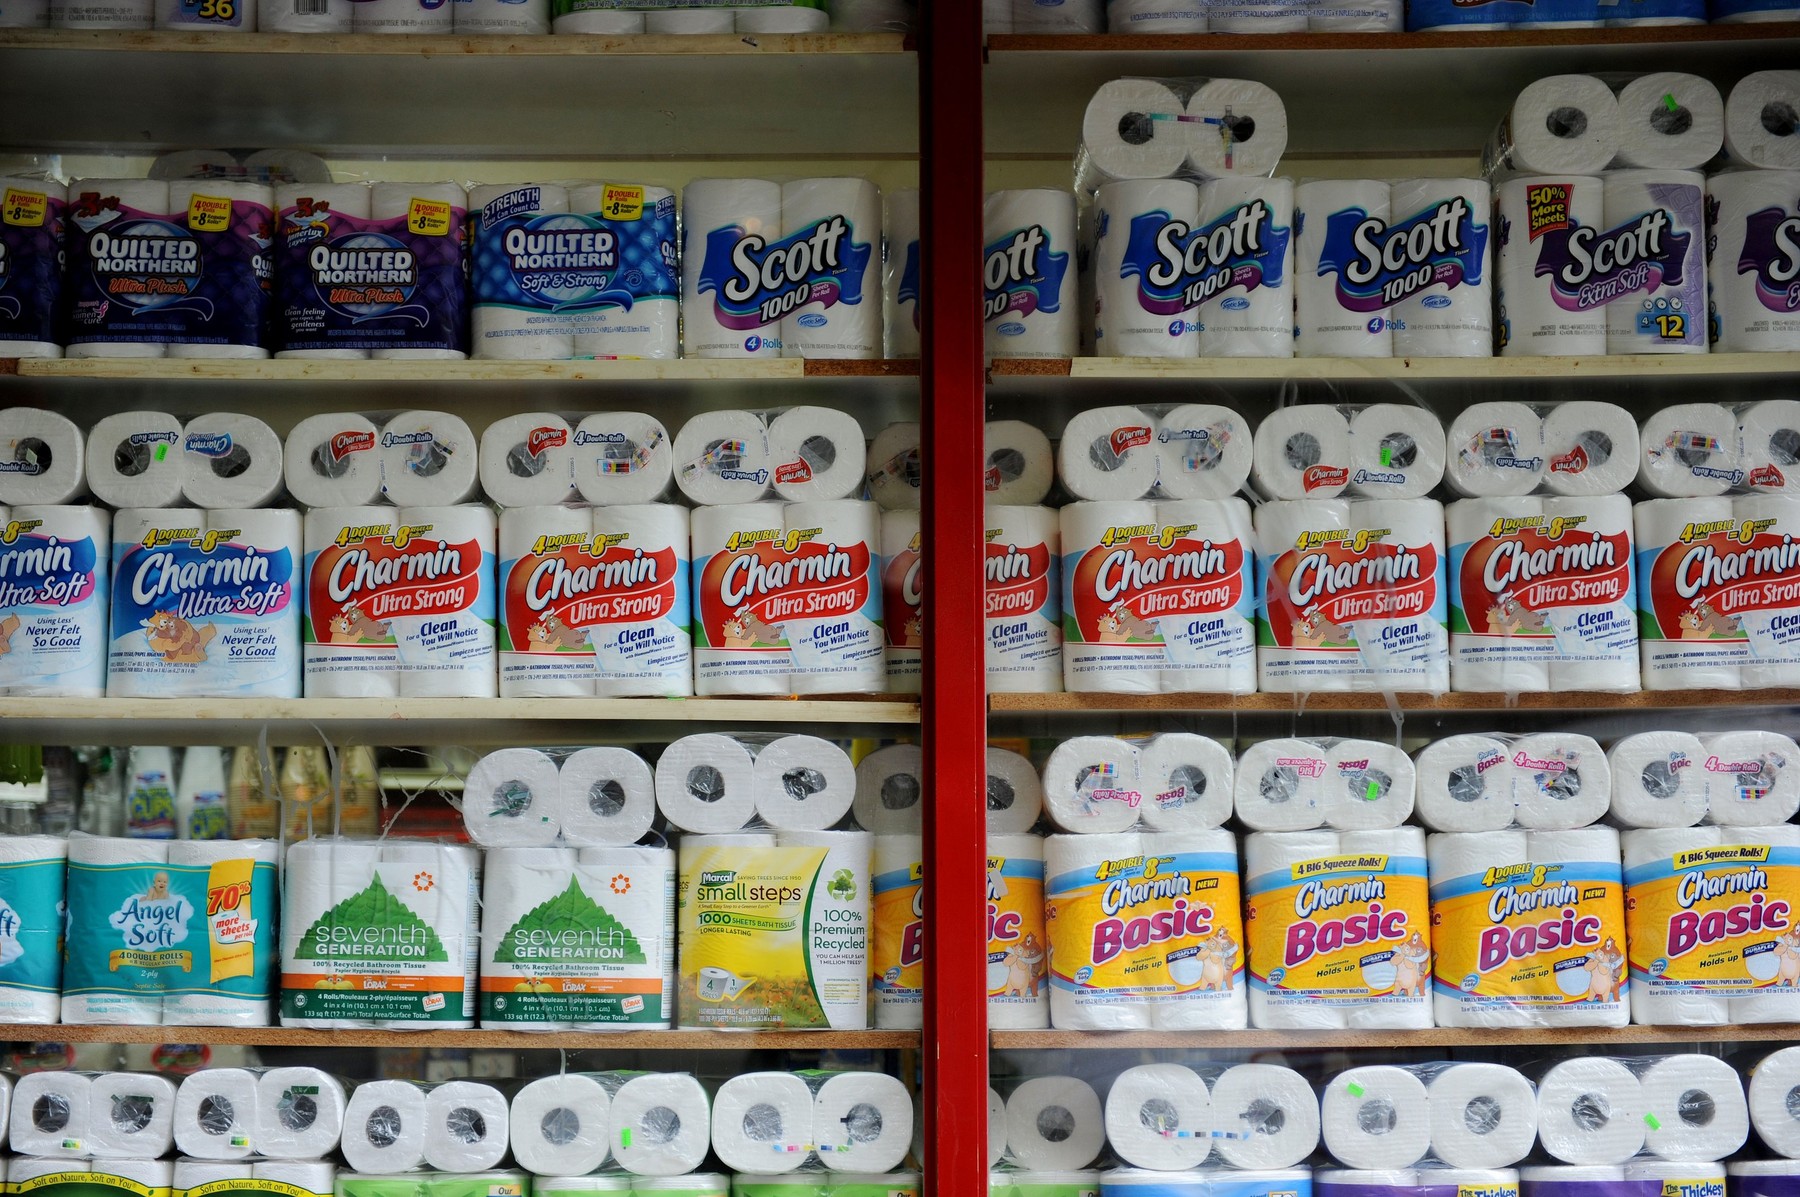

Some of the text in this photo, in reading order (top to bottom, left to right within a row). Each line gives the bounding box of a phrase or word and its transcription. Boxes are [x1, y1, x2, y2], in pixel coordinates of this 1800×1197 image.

[199, 0, 236, 20] 36
[483, 187, 540, 218] STRENGTH
[1529, 185, 1566, 202] 50%
[497, 203, 540, 221] Can Count On
[1531, 203, 1565, 217] More
[1531, 213, 1566, 231] Sheets
[89, 231, 198, 261] QUILTED
[506, 228, 614, 256] QUILTED
[1147, 199, 1266, 287] Scott
[1346, 196, 1466, 283] Scott
[1561, 208, 1668, 284] Scott
[96, 257, 197, 275] NORTHERN
[310, 244, 413, 271] QUILTED
[514, 252, 614, 269] NORTHERN
[725, 214, 847, 302] Scott
[985, 224, 1043, 291] ott
[317, 270, 411, 284] NORTHERN
[522, 273, 608, 292] Soft & Strong
[1384, 264, 1433, 304] 1000
[109, 277, 189, 296] Ultra Plush
[1183, 266, 1232, 308] 1000
[1578, 265, 1648, 308] Extra Soft
[330, 288, 405, 304] Ultra Plush
[759, 282, 810, 323] 1000
[1185, 321, 1206, 334] Rolls
[1385, 319, 1406, 331] Rolls
[1656, 315, 1685, 338] 12
[762, 338, 784, 349] Rolls
[337, 432, 370, 448] Charmin
[1310, 468, 1344, 482] Charmin
[350, 524, 392, 537] DOUBLE
[1504, 514, 1545, 530] DOUBLE
[1695, 519, 1735, 534] DOUBLE
[157, 527, 200, 539] DOUBLE
[741, 528, 781, 542] DOUBLE
[1095, 539, 1226, 602] Charmin
[1483, 530, 1615, 593] Charmin
[1675, 533, 1800, 599] Charmin
[131, 545, 269, 605] Charmin
[328, 539, 462, 603] Charmin
[525, 547, 658, 612] Charmin
[720, 542, 852, 608] Charmin
[1289, 544, 1420, 607] Charmin
[43, 573, 88, 606] Soft
[1528, 577, 1619, 607] Ultra Strong
[178, 583, 284, 619] Ultra Soft
[372, 585, 466, 617] Ultra Strong
[569, 593, 662, 625] Ultra Strong
[765, 588, 856, 620] Ultra Strong
[986, 590, 1035, 613] Strong
[1140, 585, 1230, 616] Ultra Strong
[1333, 590, 1424, 620] Ultra Strong
[1722, 588, 1761, 612] Ultra
[36, 617, 56, 628] Using
[420, 618, 458, 637] Clean
[1187, 619, 1224, 637] Clean
[1578, 610, 1614, 628] Clean
[26, 625, 81, 636] Never Felt
[233, 626, 252, 636] Using
[421, 627, 479, 648] You Will Notice
[618, 627, 655, 646] Clean
[813, 621, 850, 640] Clean
[992, 621, 1028, 639] Clean
[1025, 630, 1049, 642] Notice
[1382, 623, 1419, 641] Clean
[1578, 623, 1610, 637] You Will
[33, 635, 81, 647] So Good
[221, 634, 276, 646] Never Felt
[814, 630, 869, 650] You Will Notice
[228, 645, 277, 657] So Good
[1477, 755, 1505, 772] Basic
[1156, 787, 1185, 802] Basic
[1109, 855, 1145, 870] DOUBLE
[1688, 847, 1764, 863] BIG Squeeze Rolls!
[1306, 857, 1382, 873] BIG Squeeze Rolls!
[702, 871, 735, 884] Marcal
[1198, 880, 1217, 889] NEW!
[697, 882, 802, 906] small steps
[1102, 870, 1191, 916] Charmin
[1294, 873, 1386, 919] Charmin
[1677, 864, 1768, 910] Charmin
[208, 881, 252, 915] 70%
[1487, 879, 1579, 924] Charmin
[117, 897, 183, 925] Angel
[823, 909, 863, 923] 100%
[216, 917, 240, 930] more
[699, 913, 796, 928] 1000 SHEETS BATH TISSUE
[814, 922, 866, 936] Premium
[1667, 893, 1789, 957] Basic
[129, 921, 176, 948] Soft
[315, 923, 426, 944] seventh
[514, 926, 625, 946] seventh
[725, 928, 752, 938] LASTING
[1091, 899, 1213, 964] Basic
[1285, 903, 1406, 967] Basic
[1479, 909, 1600, 972] Basic
[315, 943, 426, 957] GENERATION
[514, 946, 624, 959] GENERATION
[814, 936, 866, 952] Recycled
[126, 951, 184, 961] DOUBLE ROLLS
[333, 961, 365, 969] Recycled
[366, 961, 402, 969] Bathroom
[1699, 954, 1739, 969] Holds up
[565, 964, 600, 972] Bathroom
[1124, 963, 1151, 975] Holds
[1316, 966, 1342, 978] Holds
[1510, 972, 1536, 983] Holds
[413, 1011, 431, 1020] Totale
[32, 1172, 104, 1188] Soft Nature, Soft
[200, 1179, 273, 1195] Soft Nature, Soft
[1666, 1184, 1680, 1195] The
